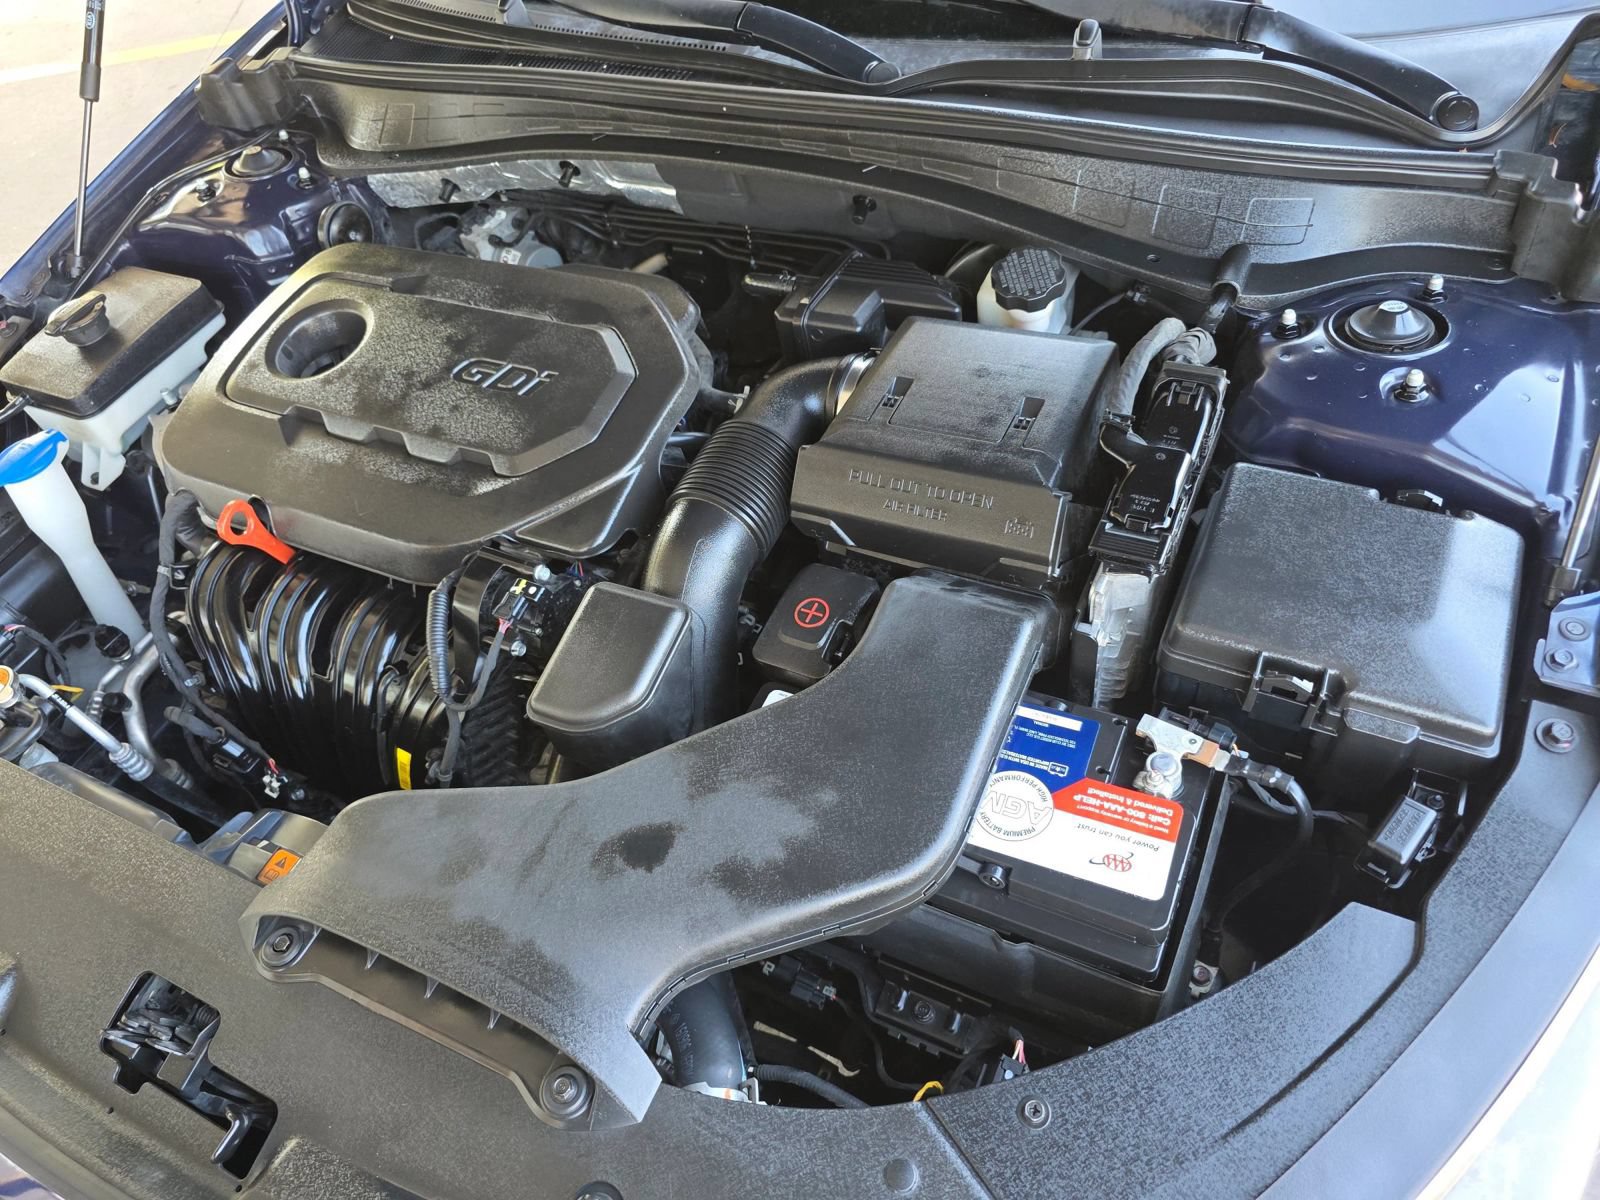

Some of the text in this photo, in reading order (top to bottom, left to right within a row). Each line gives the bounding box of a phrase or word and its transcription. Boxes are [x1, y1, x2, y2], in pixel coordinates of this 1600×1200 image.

[849, 468, 994, 510] PULL OUT TO OPEN
[882, 498, 948, 522] AIR FILTER
[1036, 788, 1048, 802] HIGH
[1087, 787, 1125, 803] Installed!
[1073, 794, 1171, 826] Call: 800-AAA-HELP
[1133, 799, 1174, 817] Delivered
[979, 811, 1036, 837] PREMIUM BATTERY
[1077, 823, 1159, 852] Power you can trust
[1105, 855, 1130, 872] AAA
